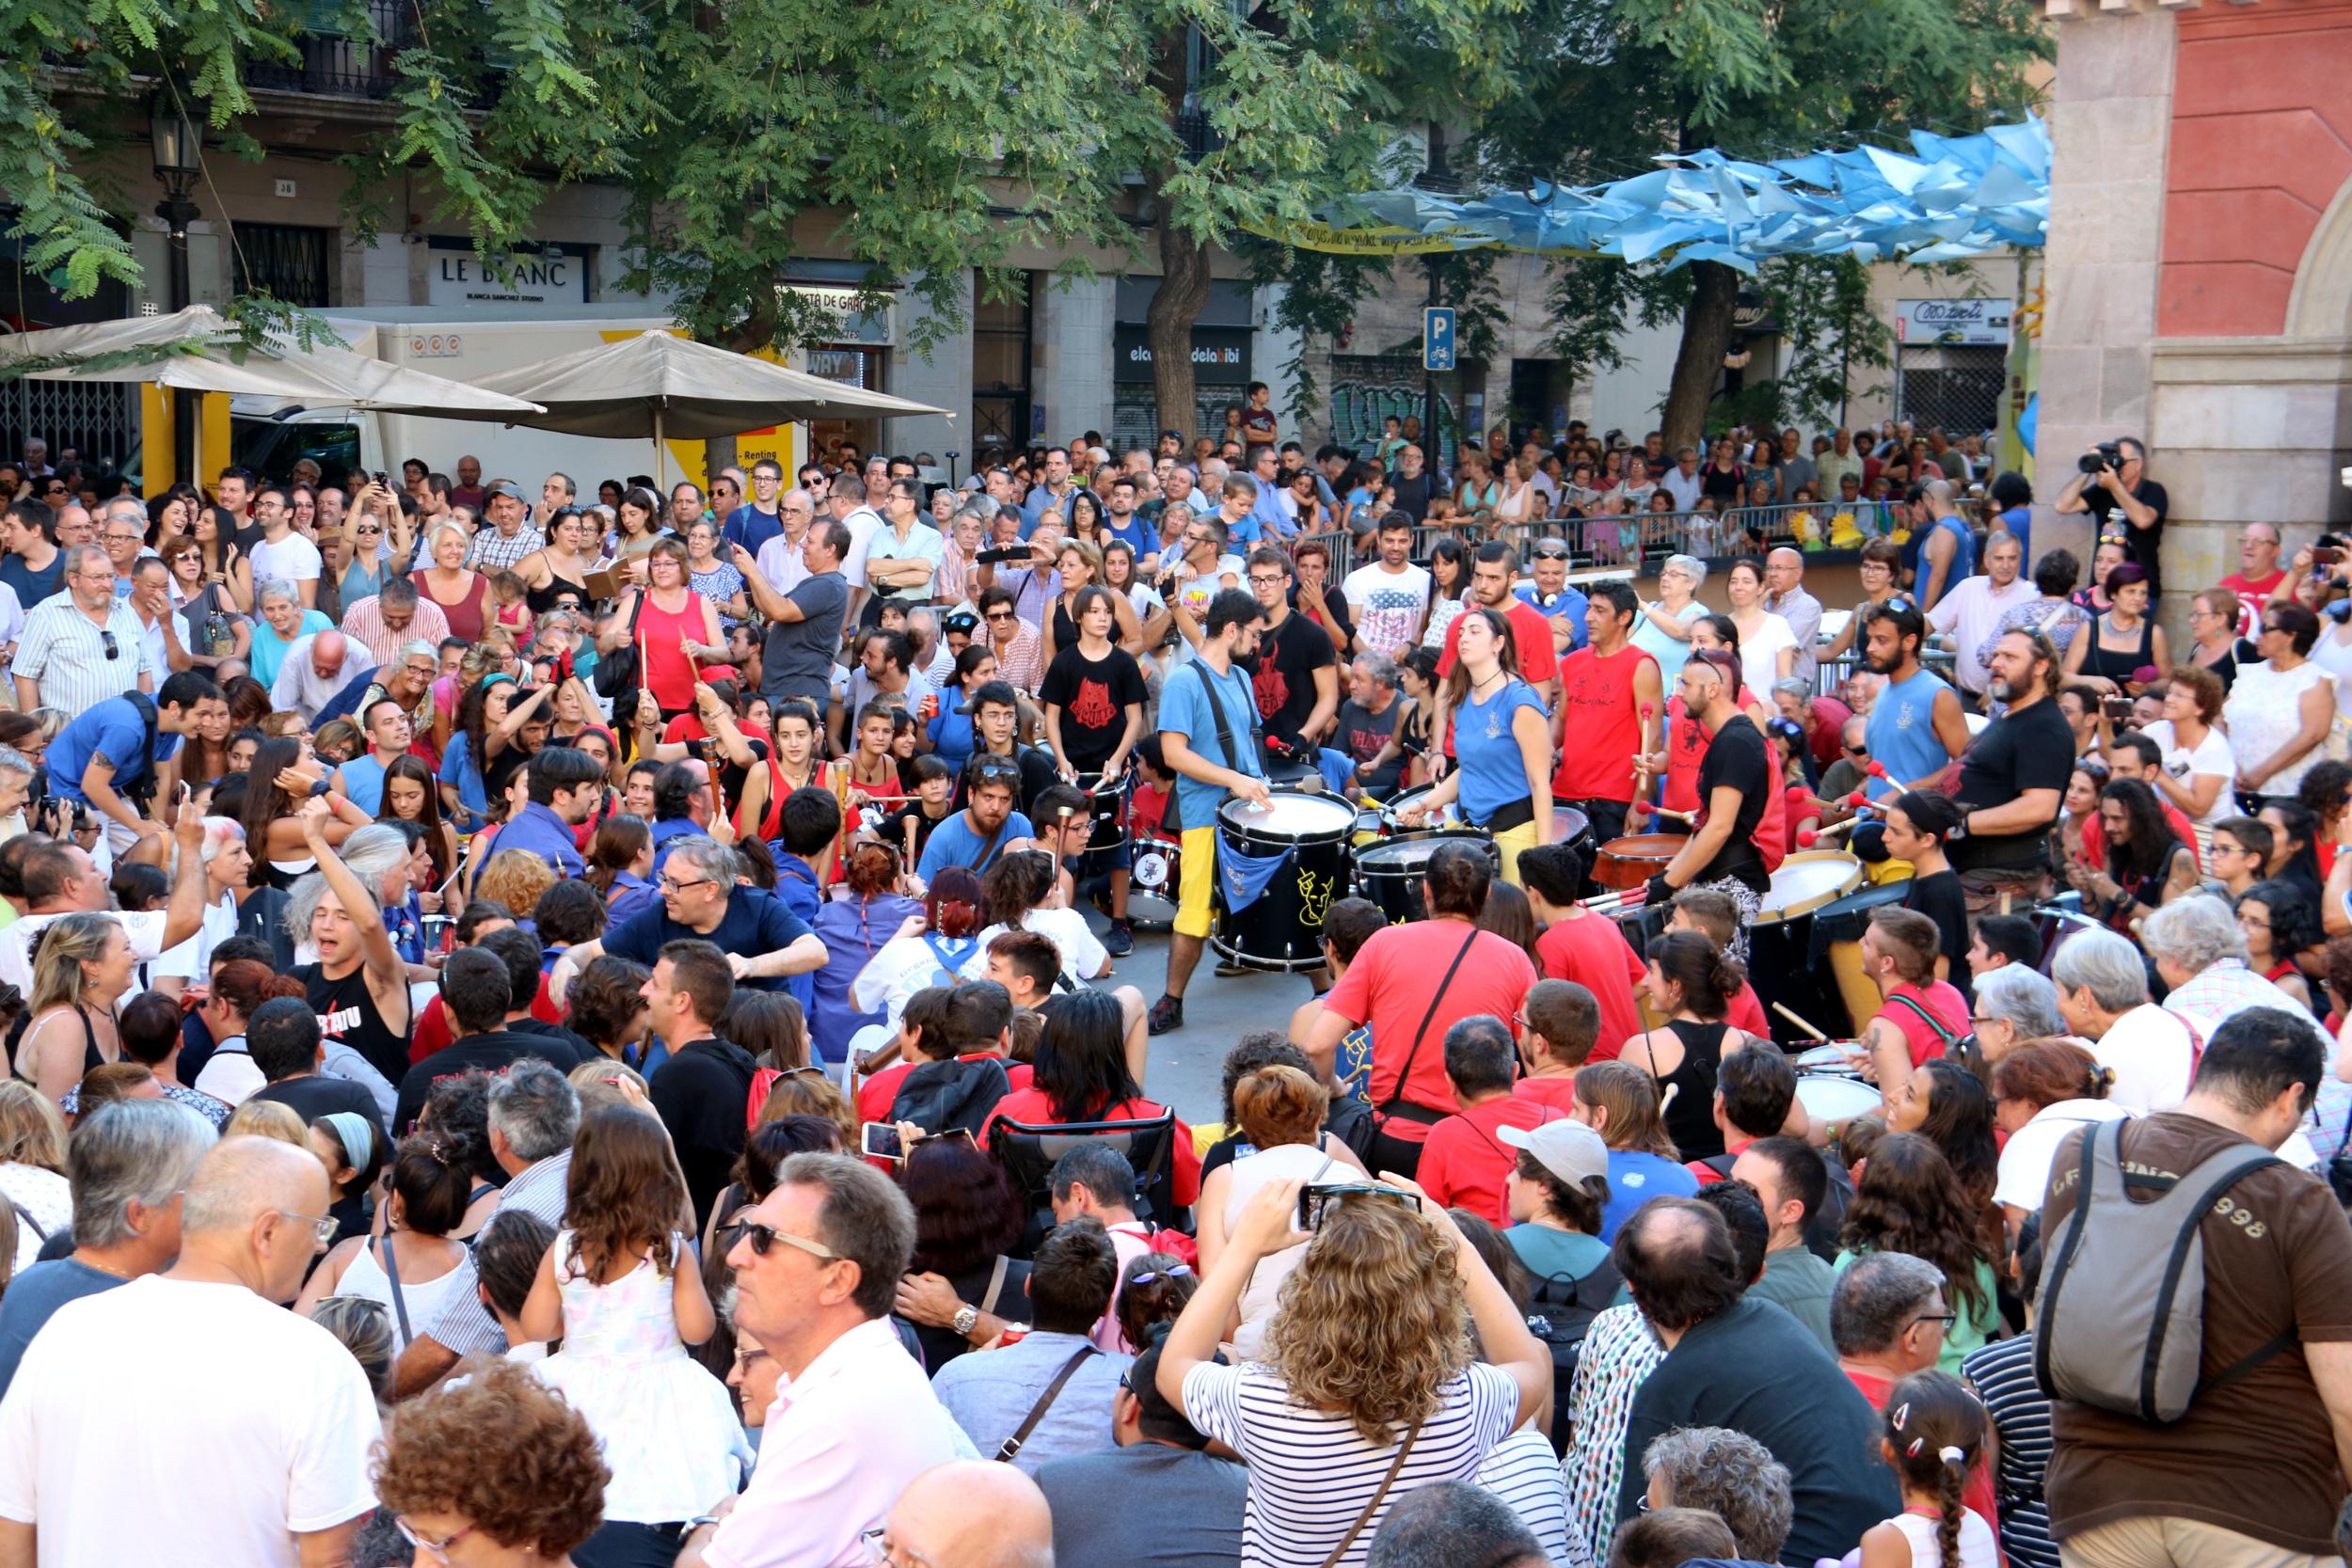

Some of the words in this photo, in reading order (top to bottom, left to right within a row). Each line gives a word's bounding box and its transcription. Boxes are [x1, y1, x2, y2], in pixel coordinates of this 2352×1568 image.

[441, 258, 469, 282] LE
[467, 293, 491, 301] BLANCA
[492, 293, 519, 302] SANCHEZ
[521, 294, 544, 303] STUDIO
[824, 294, 836, 309] DE
[1433, 316, 1447, 340] P
[745, 451, 777, 462] Renting
[2213, 1196, 2267, 1239] 998
